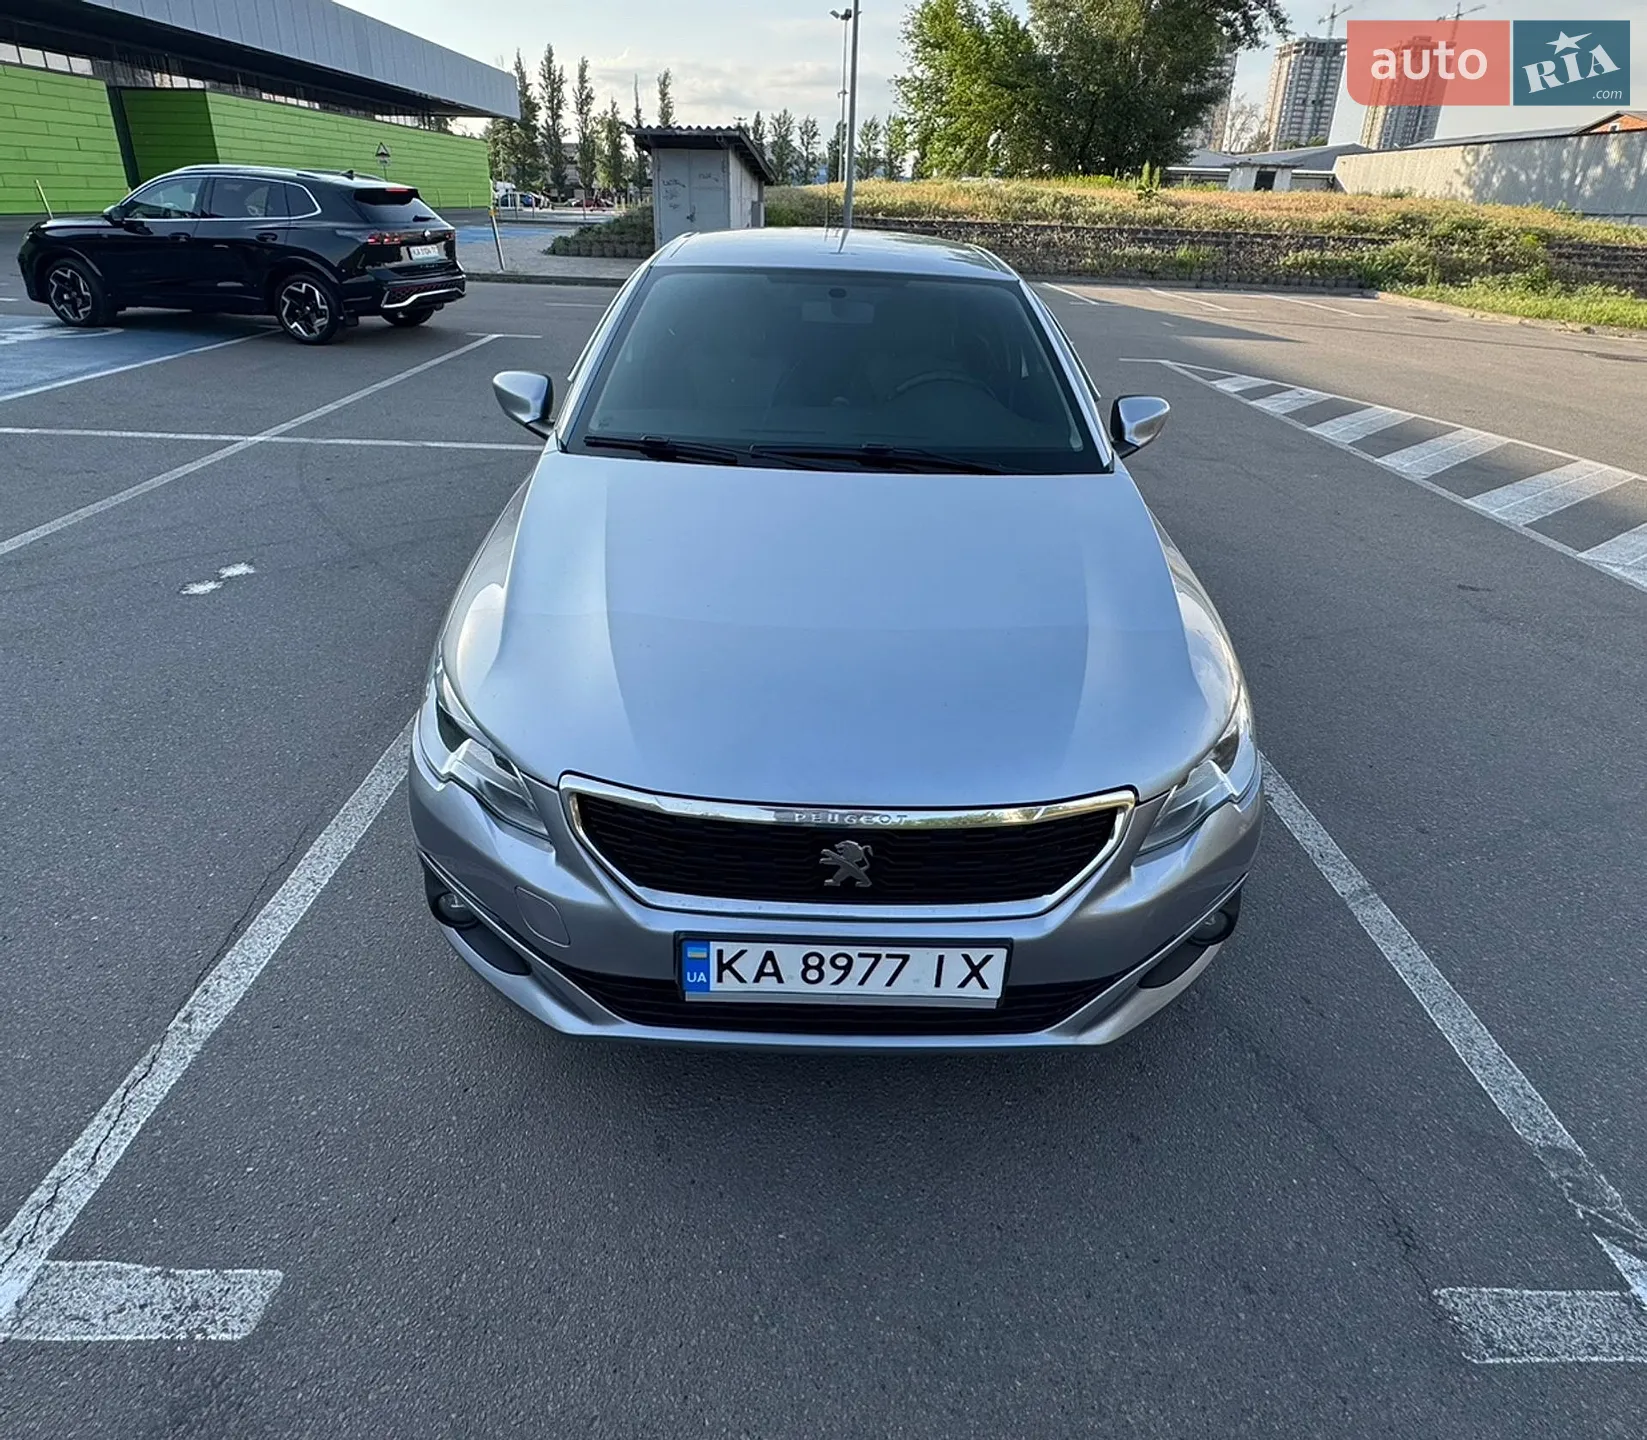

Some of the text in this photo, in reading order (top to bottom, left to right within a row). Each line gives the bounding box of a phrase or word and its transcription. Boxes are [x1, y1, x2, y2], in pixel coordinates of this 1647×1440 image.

[794, 812, 908, 826] PEUGEOT
[715, 948, 995, 990] KA 8977 IX
[686, 971, 708, 984] UA
